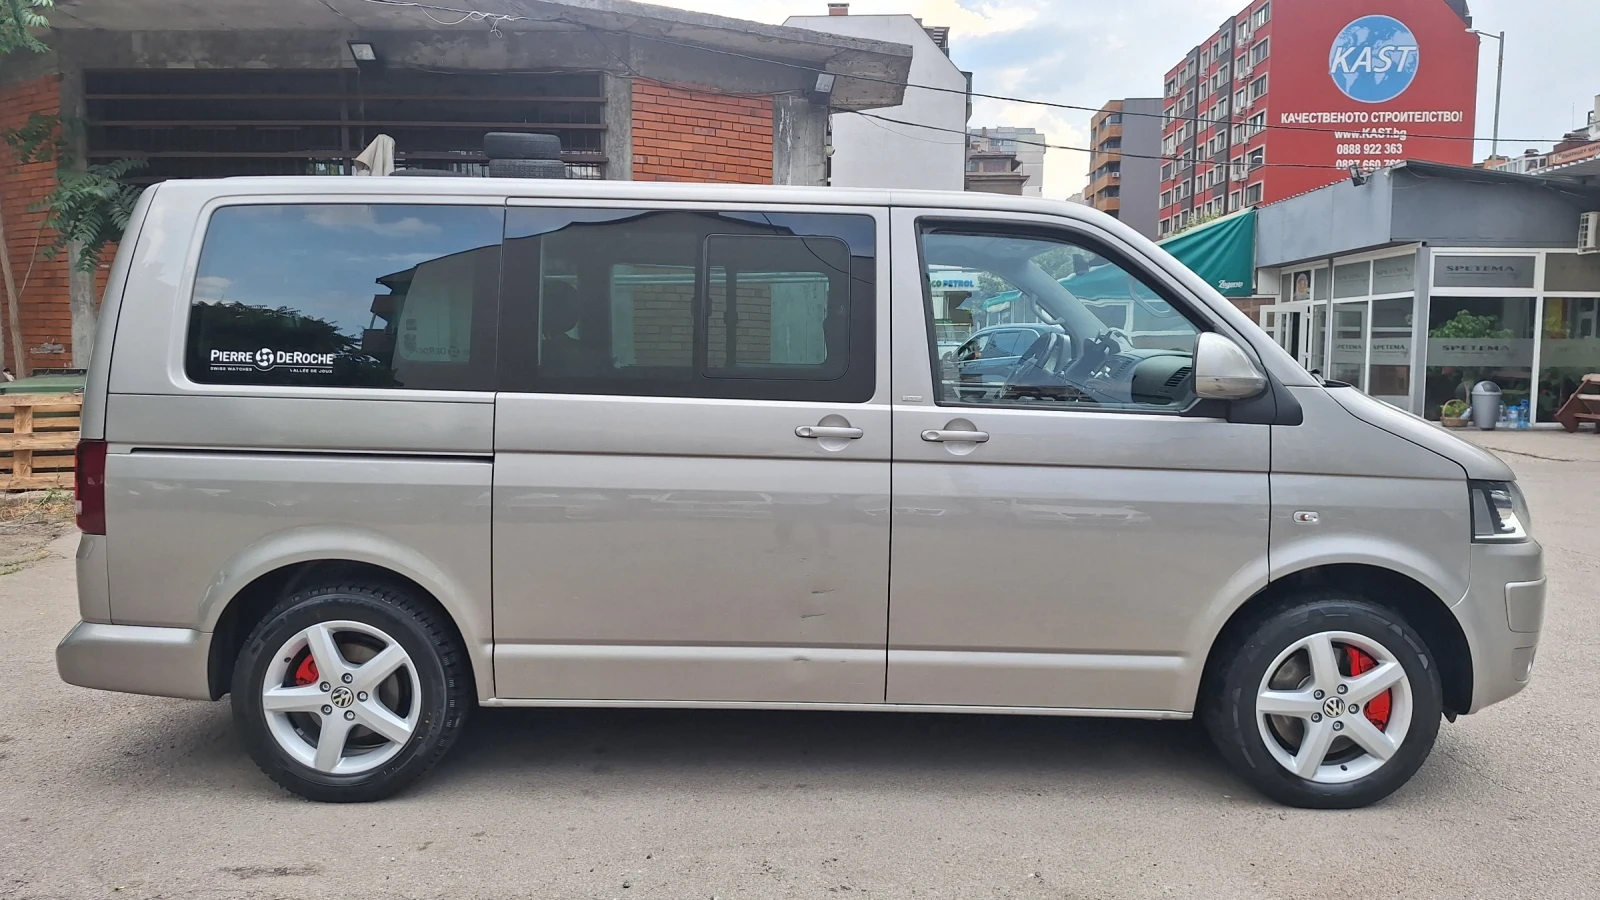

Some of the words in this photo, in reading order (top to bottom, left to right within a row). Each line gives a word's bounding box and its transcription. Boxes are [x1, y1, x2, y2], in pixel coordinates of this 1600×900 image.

[1330, 45, 1418, 73] KAST
[1280, 112, 1369, 124] КАЧЕСТВЕНОТО
[1370, 111, 1463, 123] СТРОИТЕЛСТВО!
[1334, 127, 1407, 141] www.KAST.bg
[1336, 144, 1361, 155] 0888
[1363, 144, 1382, 155] 922
[1384, 144, 1403, 155] 363
[1442, 344, 1511, 352] SPETEMA
